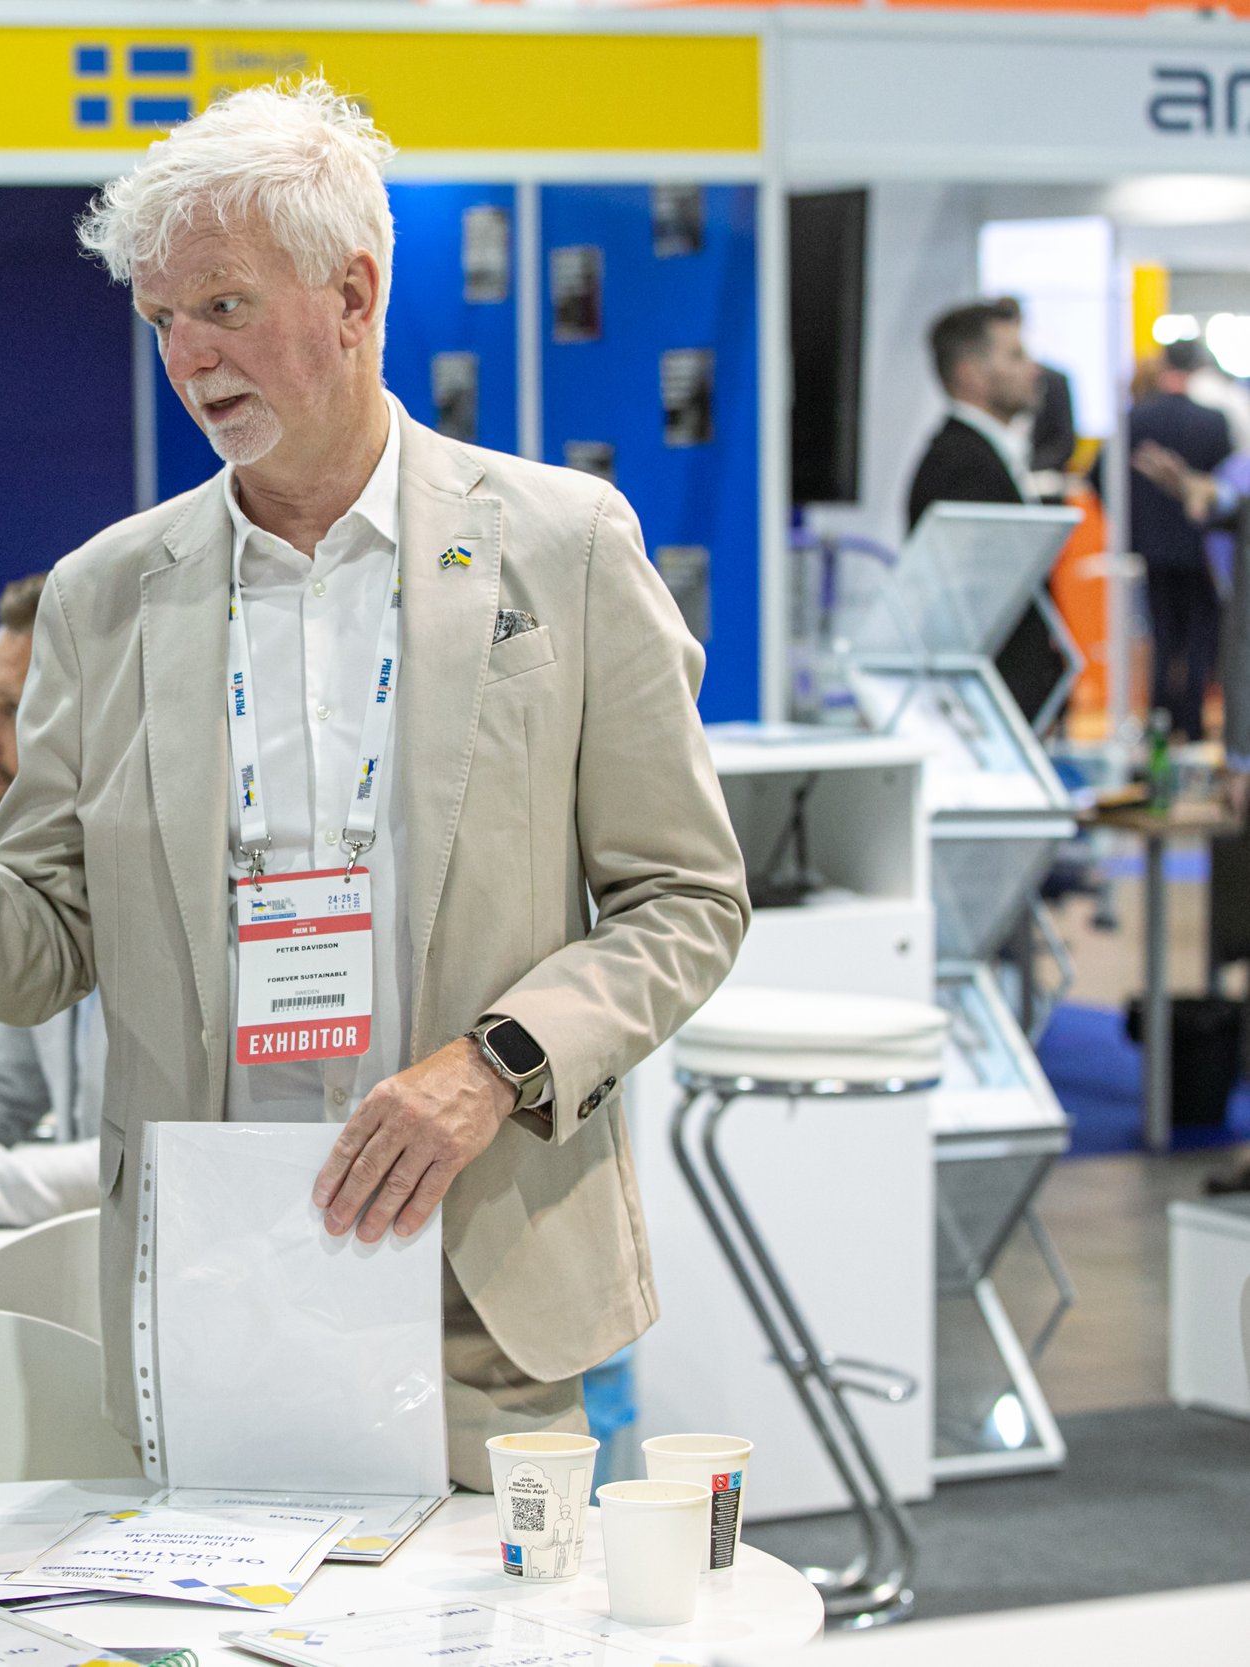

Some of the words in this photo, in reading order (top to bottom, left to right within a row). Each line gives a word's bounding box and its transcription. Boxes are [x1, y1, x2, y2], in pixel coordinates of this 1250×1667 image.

[328, 893, 352, 905] 24-25
[276, 946, 299, 954] PETER
[301, 942, 339, 951] DAVIDSON
[267, 974, 299, 984] FOREVER
[300, 970, 348, 981] SUSTAINABLE
[249, 1026, 358, 1056] EXHIBITOR
[130, 1538, 199, 1546] HANSSON
[151, 1533, 256, 1543] INTERNATIONAL
[73, 1549, 223, 1562] GRATITUDE
[113, 1555, 214, 1568] LETTER
[230, 1556, 265, 1566] OF
[5, 1647, 40, 1656] OF
